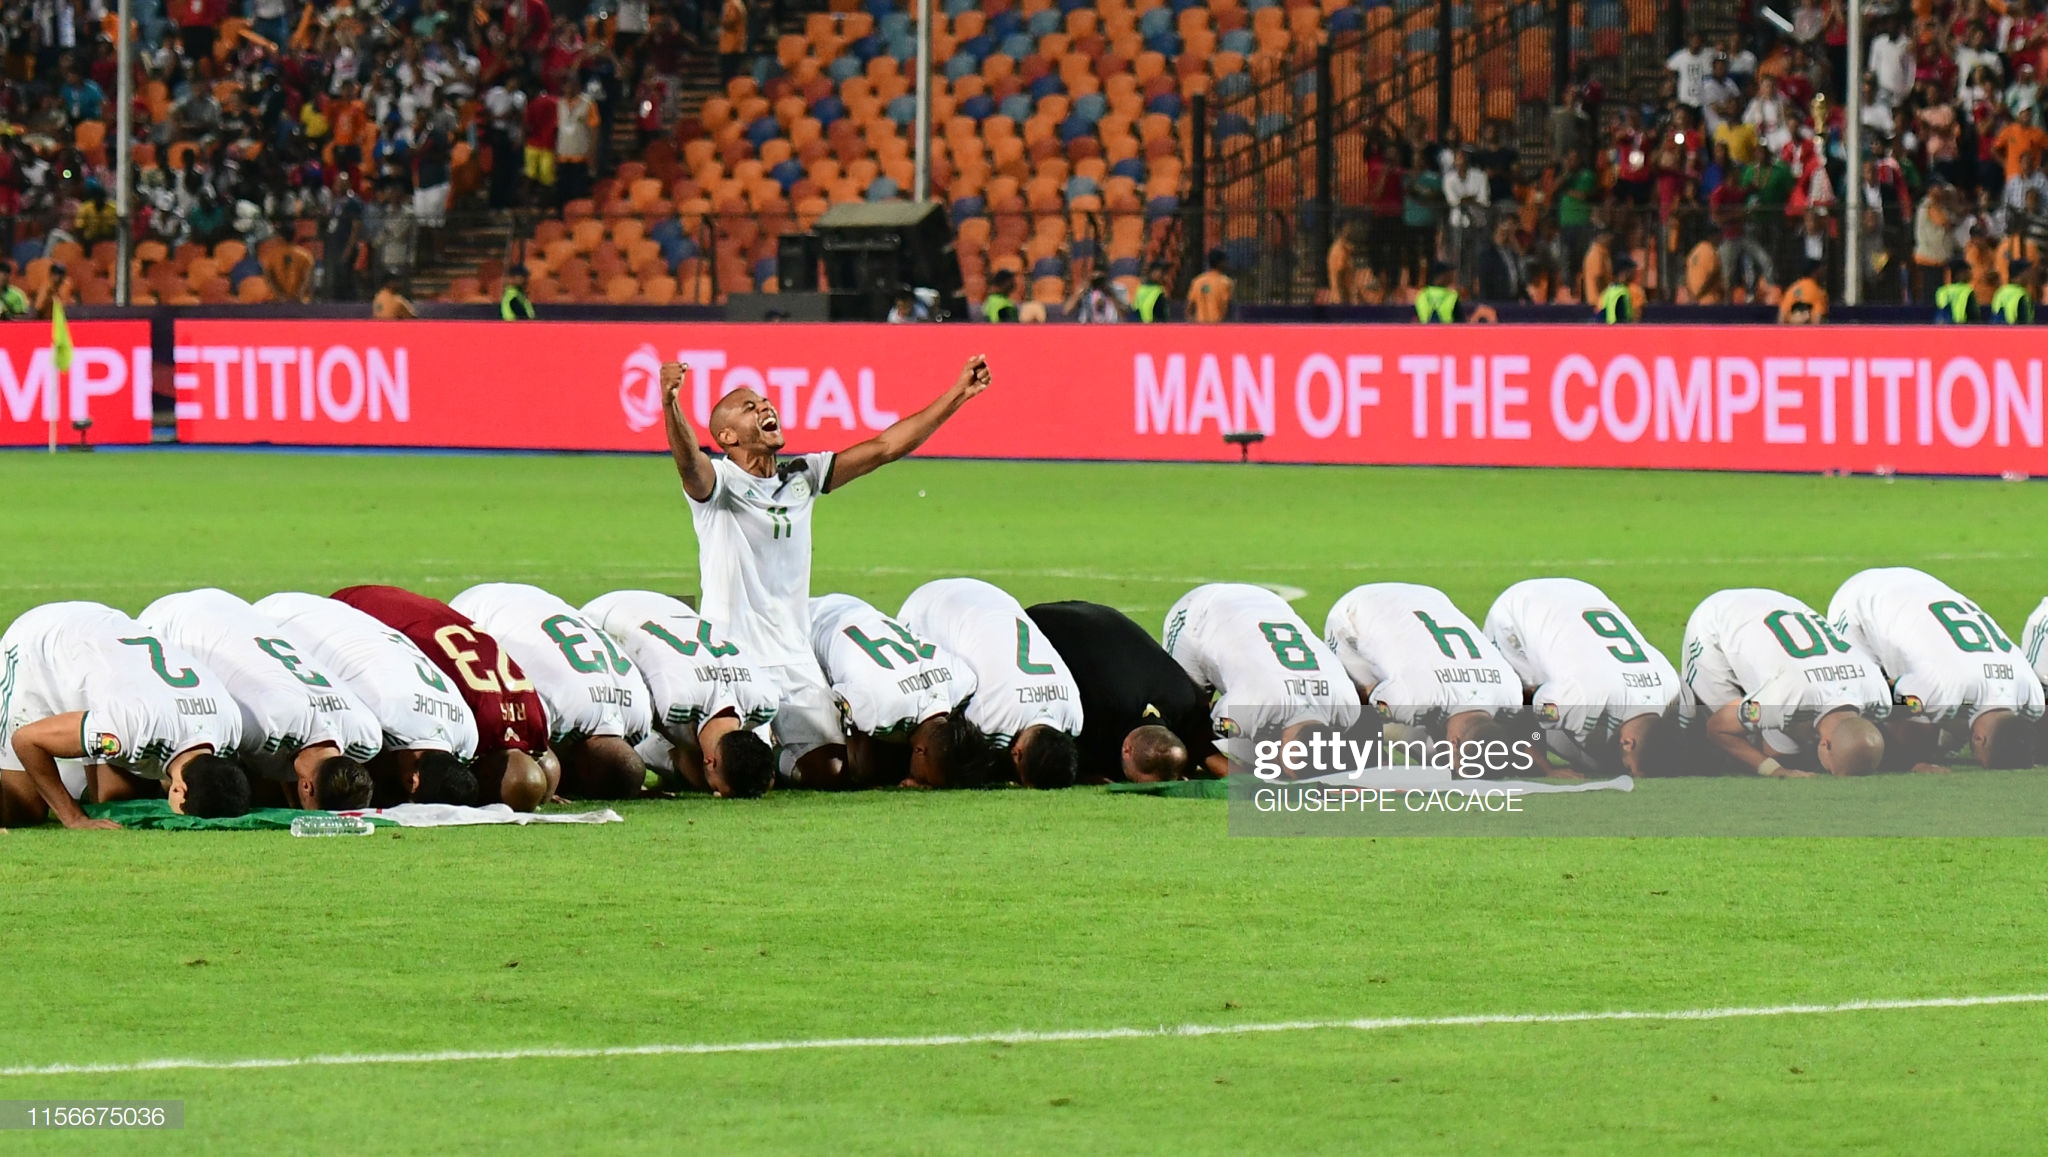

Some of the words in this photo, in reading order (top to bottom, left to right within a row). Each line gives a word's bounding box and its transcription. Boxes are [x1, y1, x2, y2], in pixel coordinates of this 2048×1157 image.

[1134, 353, 1275, 435] MAN
[1295, 353, 1382, 438] OF
[1399, 355, 1531, 439] THE
[1551, 353, 2045, 447] COMPETITION
[767, 507, 792, 539] 11
[541, 614, 632, 676] 13
[1015, 617, 1055, 675] 7
[1258, 621, 1319, 671] 8
[1412, 610, 1482, 659] 4
[1582, 610, 1649, 663] 6
[1763, 609, 1852, 659] 10
[1928, 600, 2013, 653] 19
[117, 635, 200, 688] 2
[1433, 668, 1501, 684] BENLAMRI
[1616, 671, 1662, 688] FARES
[1804, 663, 1866, 684] FEGHOULI
[1984, 663, 2014, 680] ABEID
[413, 693, 464, 724] HALLICHE
[1017, 687, 1069, 704] MAHREZ
